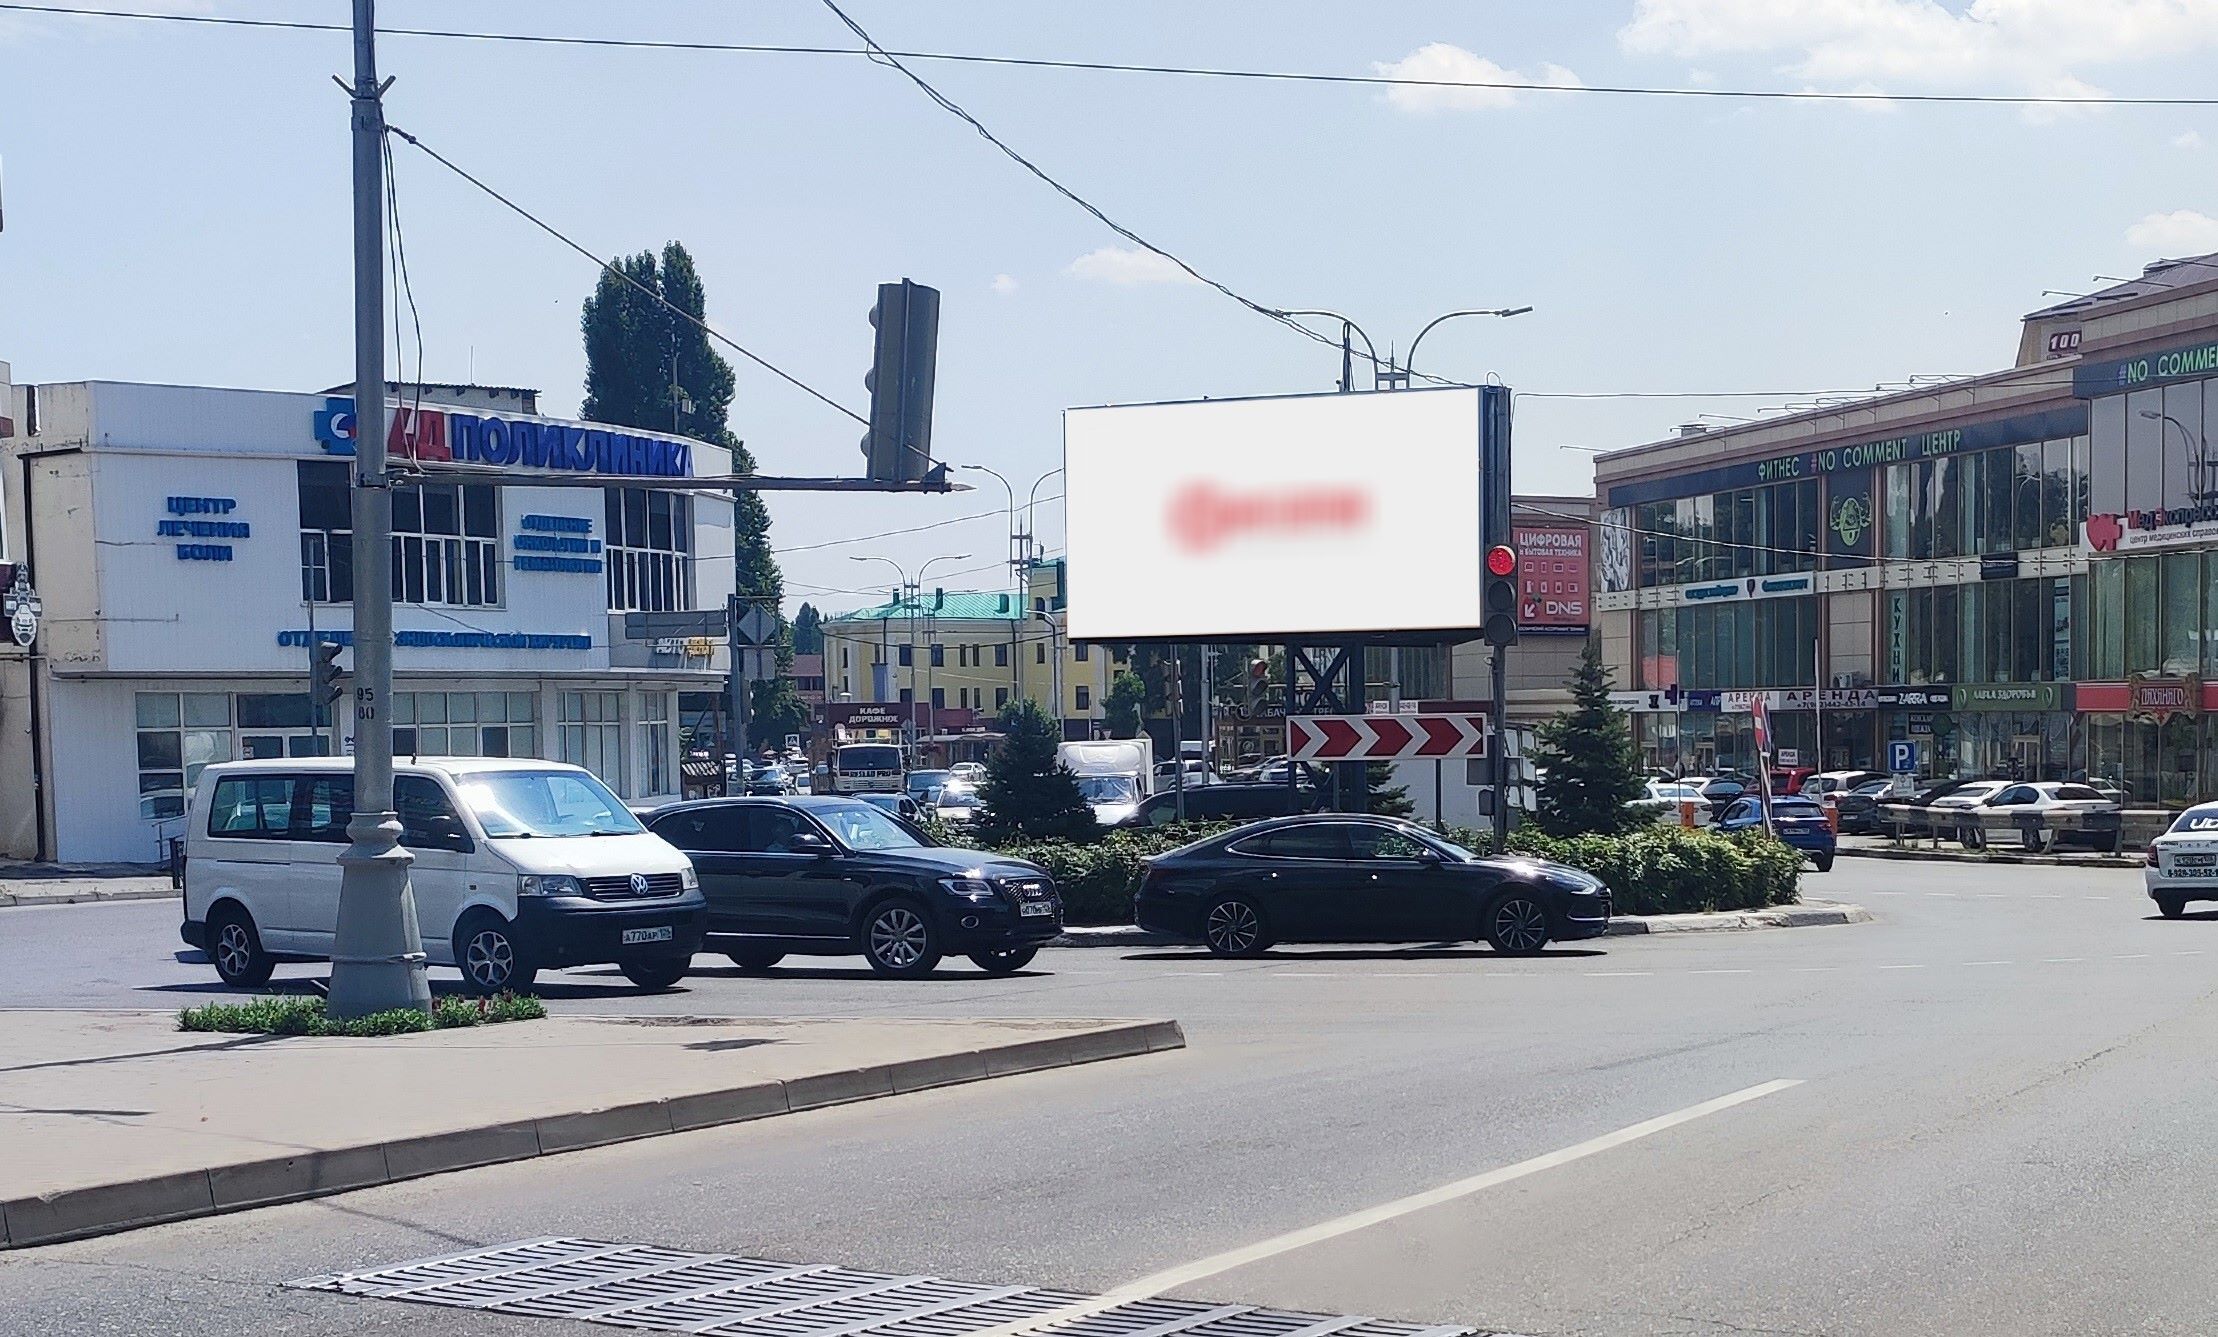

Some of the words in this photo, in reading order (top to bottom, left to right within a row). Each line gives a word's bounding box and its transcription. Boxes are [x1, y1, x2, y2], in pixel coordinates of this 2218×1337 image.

[2050, 333, 2080, 349] 100
[2157, 345, 2218, 376] COMME
[1758, 457, 1800, 481] ФИТНЕС
[1843, 438, 1907, 468] COMMENT
[1921, 430, 1960, 456] ЦЕНТР
[167, 497, 236, 516] ЦЕНТР
[157, 520, 250, 538] ЛЕЧЕНИЯ
[1520, 533, 1582, 547] ЦИФРОВАЯ
[177, 544, 233, 561] БОЛИ
[1546, 601, 1582, 615] DNS
[1893, 598, 1901, 682] КУХНИ
[357, 687, 374, 701] 95
[1787, 690, 1875, 701] АРЕНДА
[860, 707, 886, 715] КАФЕ
[849, 715, 898, 724] ДОРОЖНОЕ
[1895, 744, 1909, 770] P
